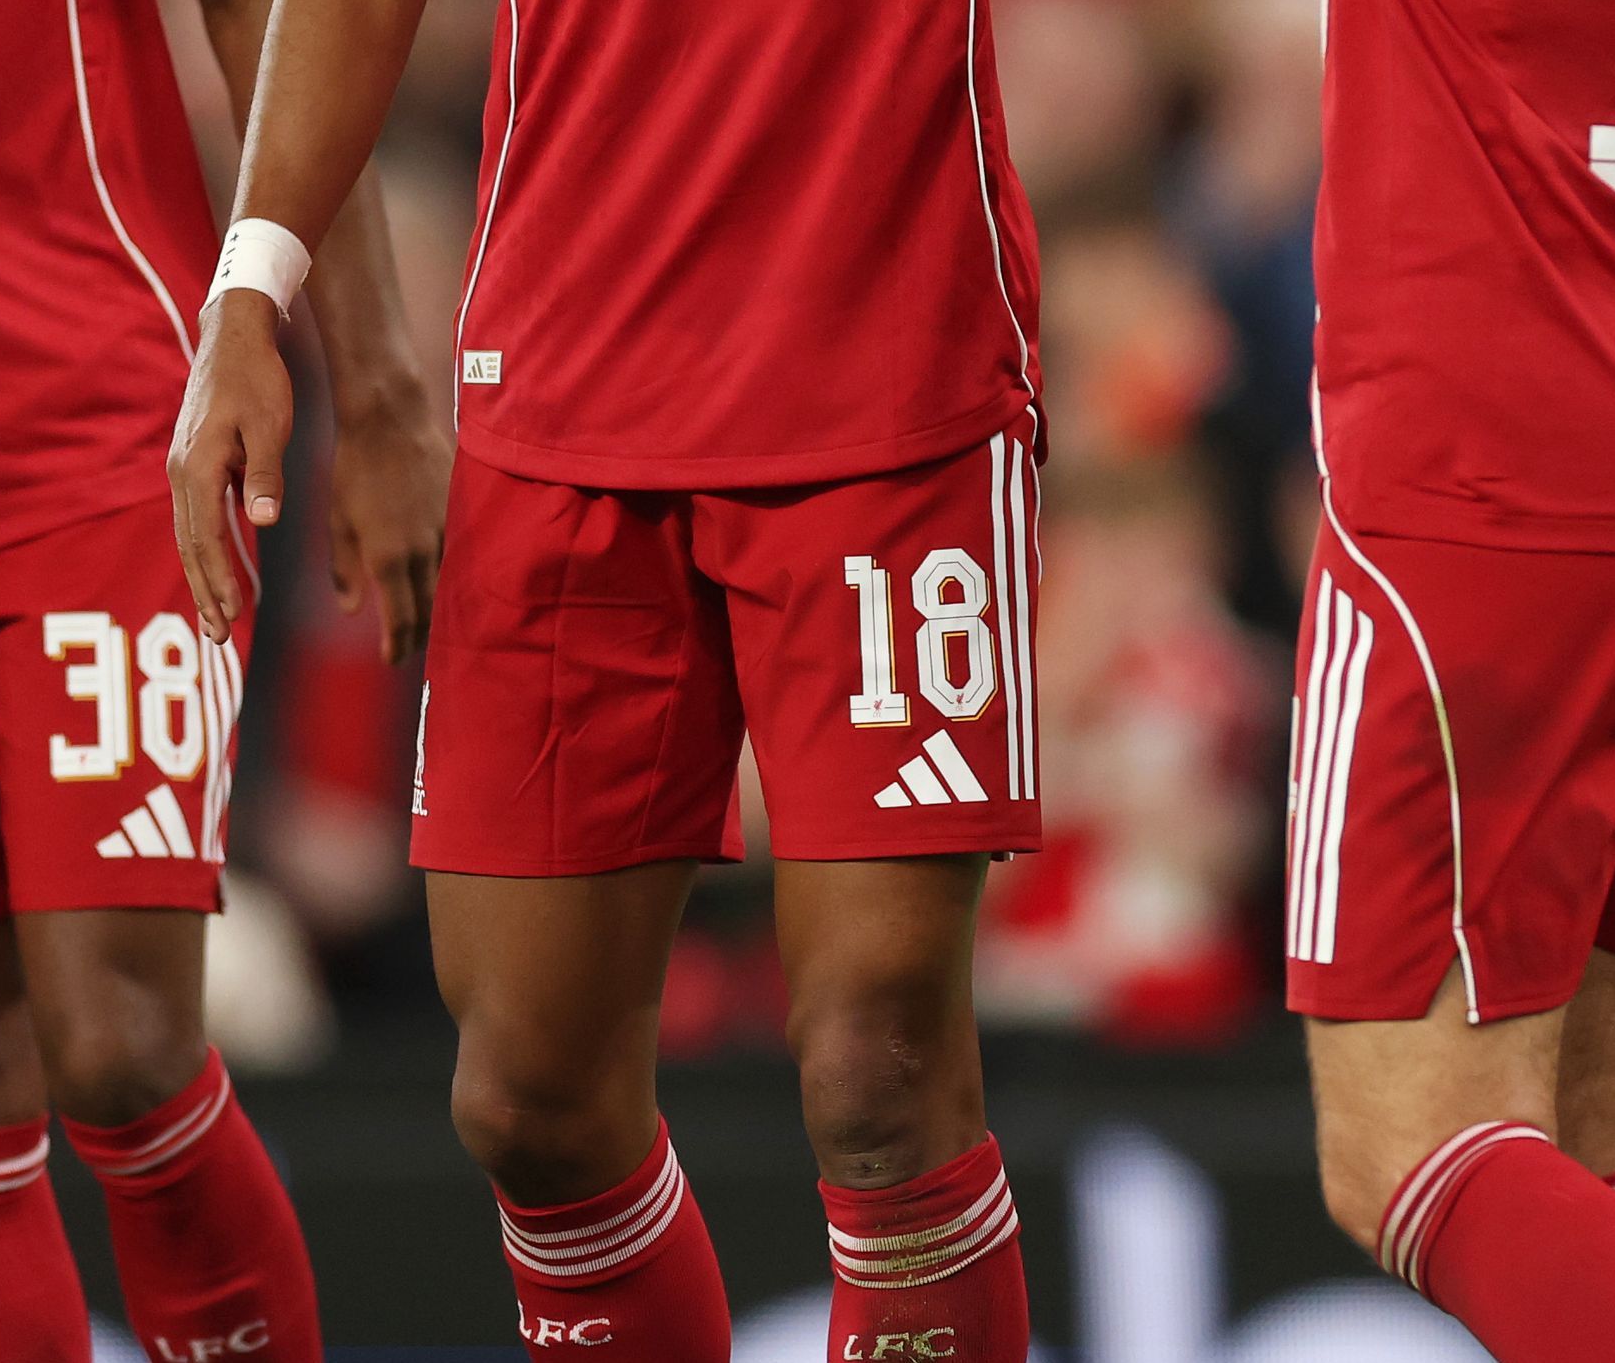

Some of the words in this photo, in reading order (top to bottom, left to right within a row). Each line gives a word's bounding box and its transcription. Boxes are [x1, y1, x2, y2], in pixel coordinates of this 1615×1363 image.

[844, 548, 998, 728] 18
[43, 611, 207, 782] 38
[516, 1297, 614, 1348] LFC
[843, 1326, 956, 1361] LFC
